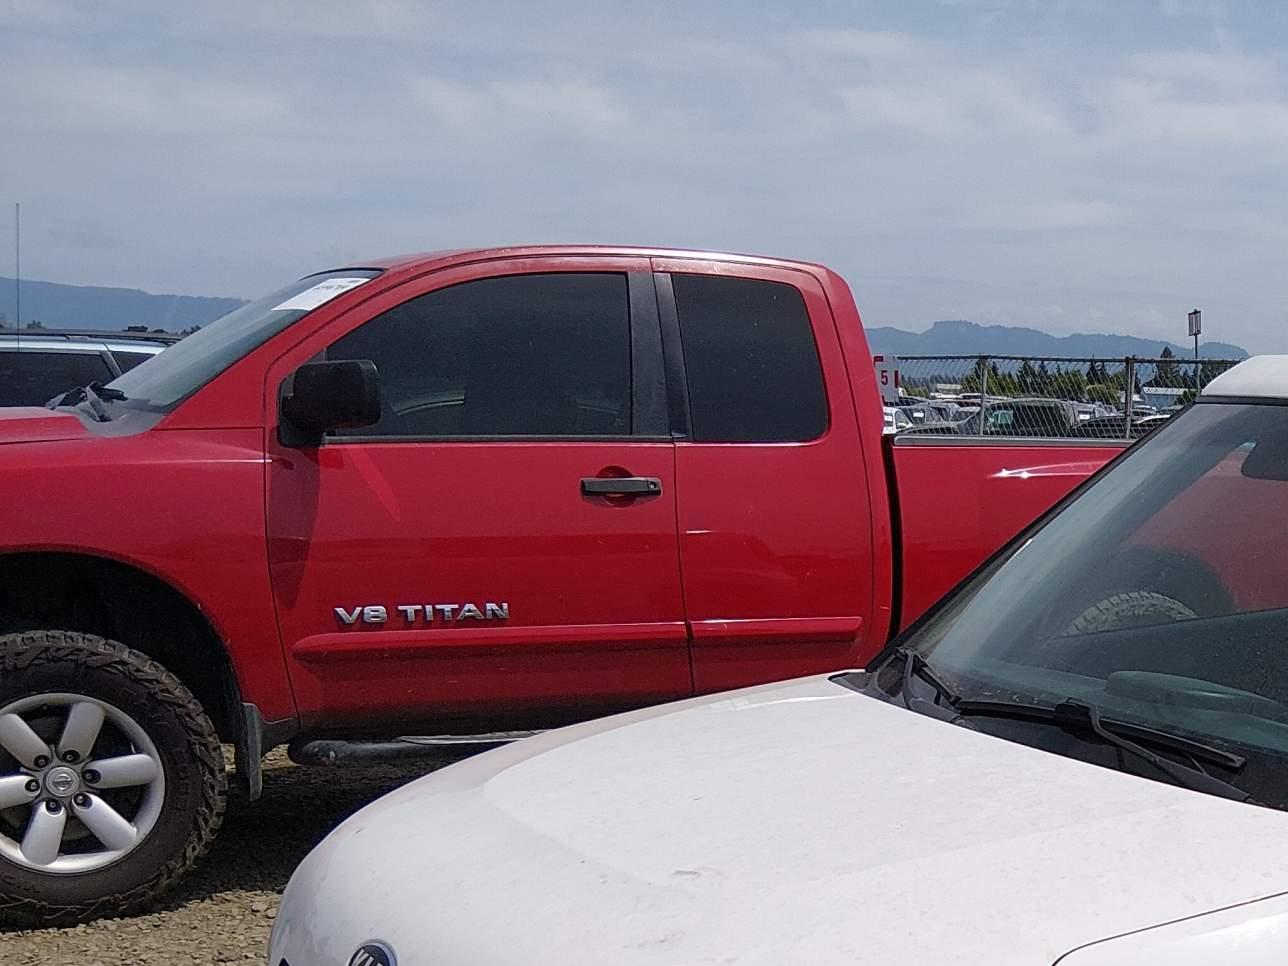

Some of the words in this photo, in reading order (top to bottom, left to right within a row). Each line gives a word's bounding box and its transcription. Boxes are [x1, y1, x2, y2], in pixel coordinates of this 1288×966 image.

[881, 369, 889, 386] 5
[334, 605, 388, 624] V8
[397, 602, 510, 622] TITAN
